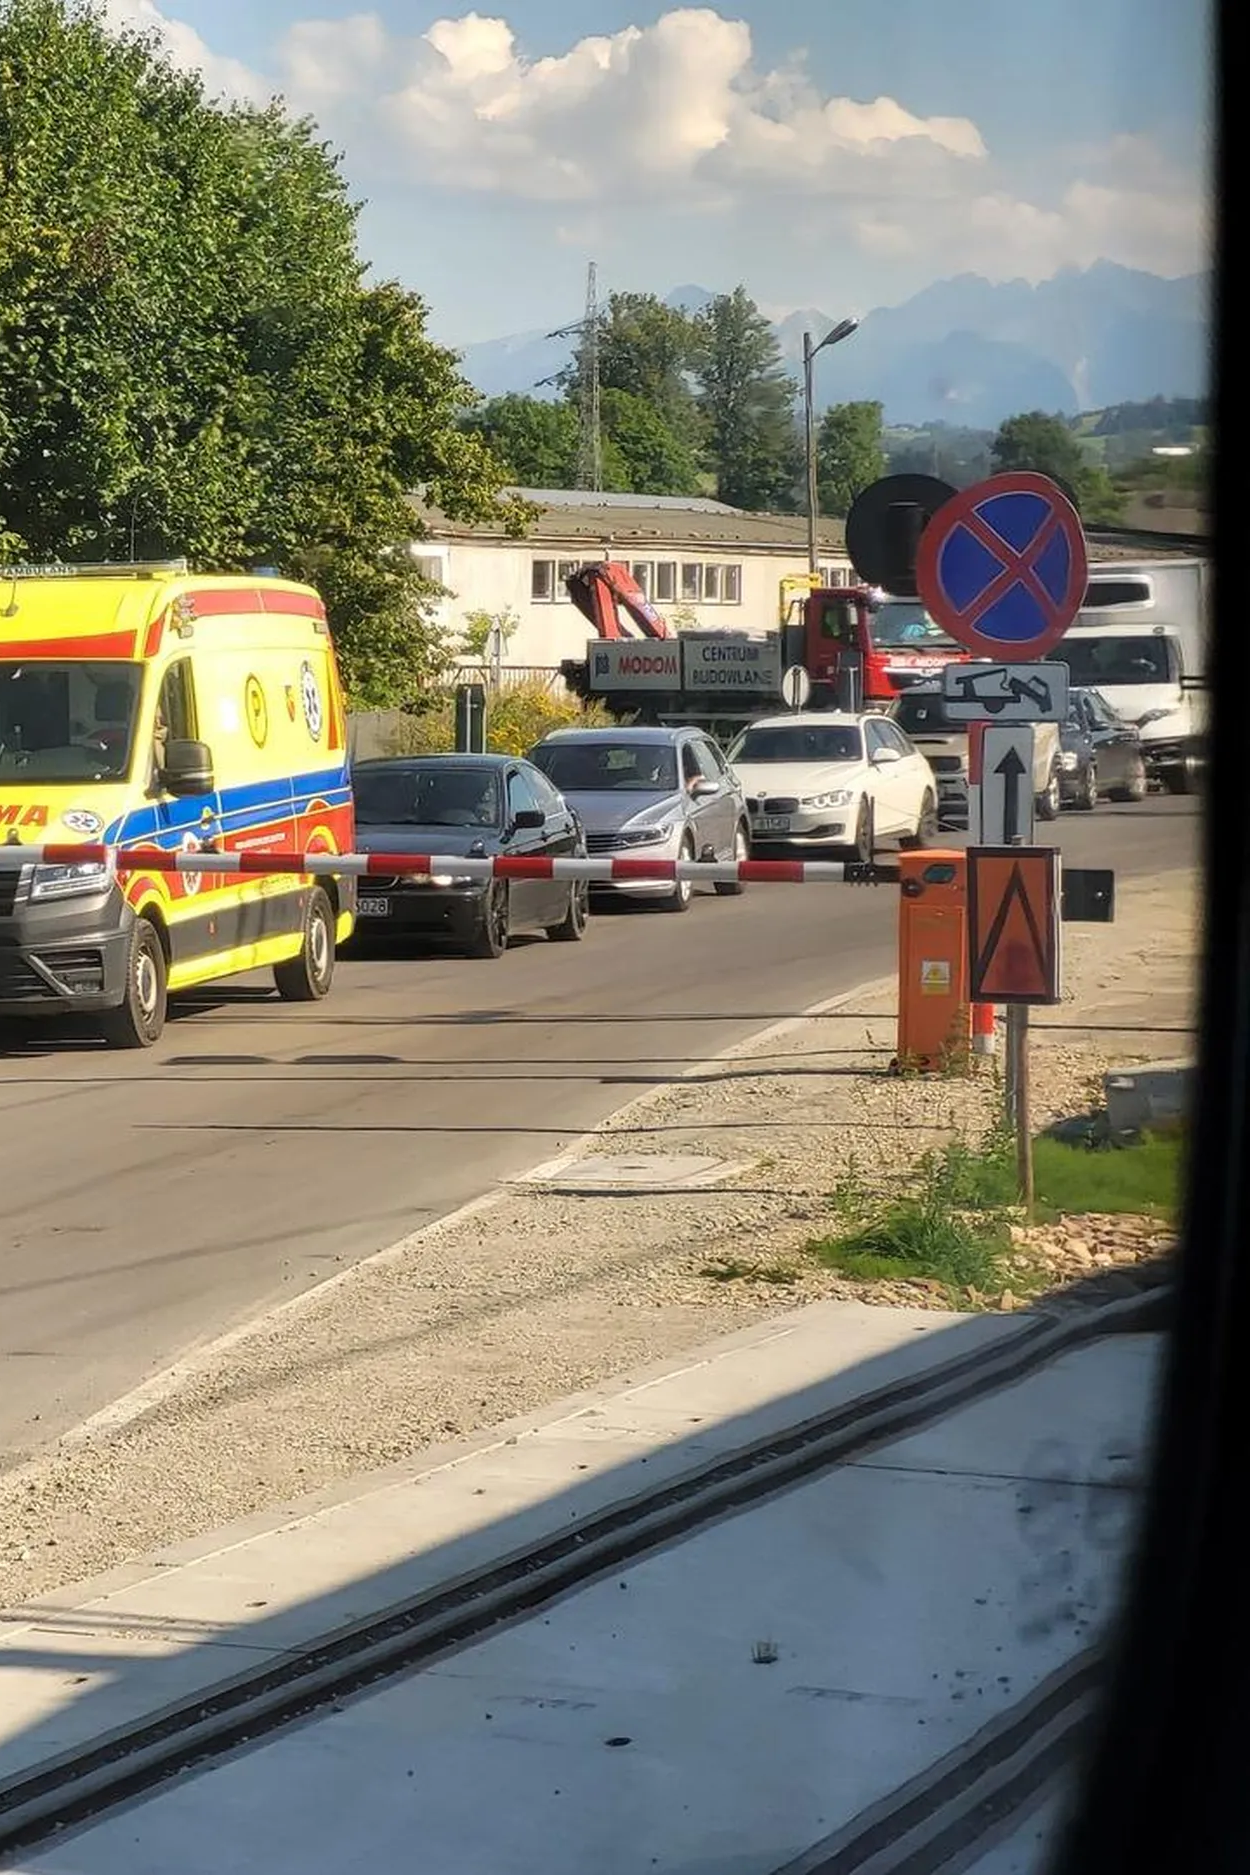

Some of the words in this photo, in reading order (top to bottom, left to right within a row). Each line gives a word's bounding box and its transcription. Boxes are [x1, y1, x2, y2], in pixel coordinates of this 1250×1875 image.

[4, 566, 78, 577] AMBULANS
[702, 646, 759, 662] CENTRUM
[617, 656, 678, 676] MODOM
